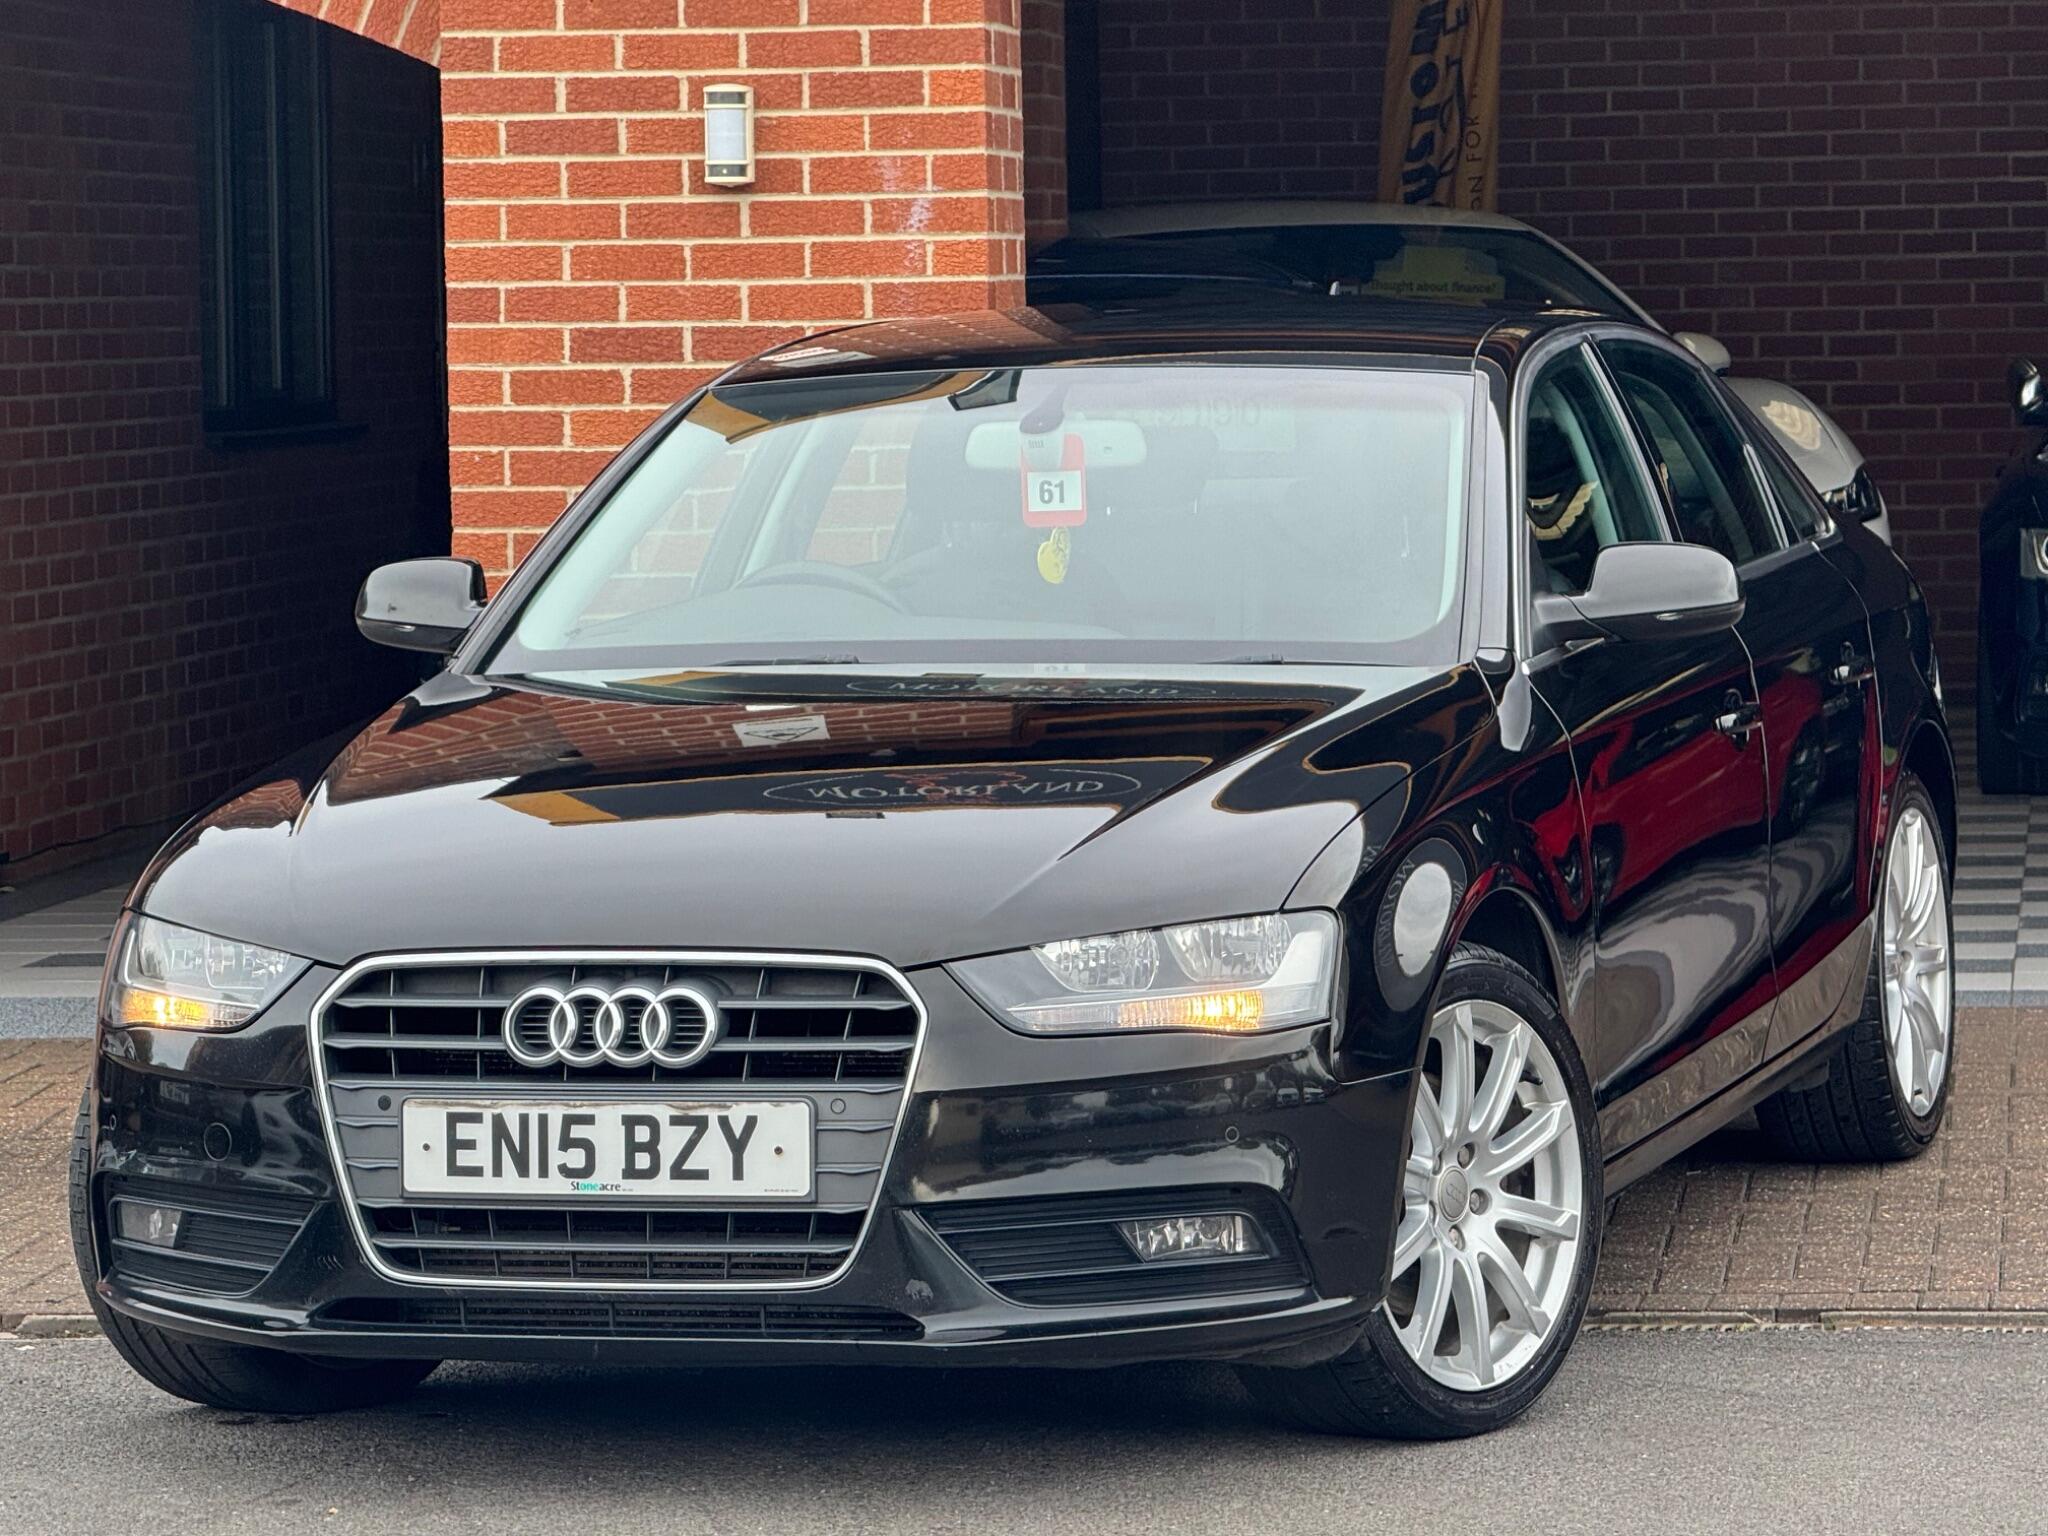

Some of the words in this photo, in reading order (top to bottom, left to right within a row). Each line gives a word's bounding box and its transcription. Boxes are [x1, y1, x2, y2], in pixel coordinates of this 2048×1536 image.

[1416, 281, 1449, 292] about
[1038, 479, 1066, 504] 61
[445, 1111, 596, 1180] EN15
[620, 1113, 758, 1181] BZY
[570, 1181, 621, 1192] Stoneacre
